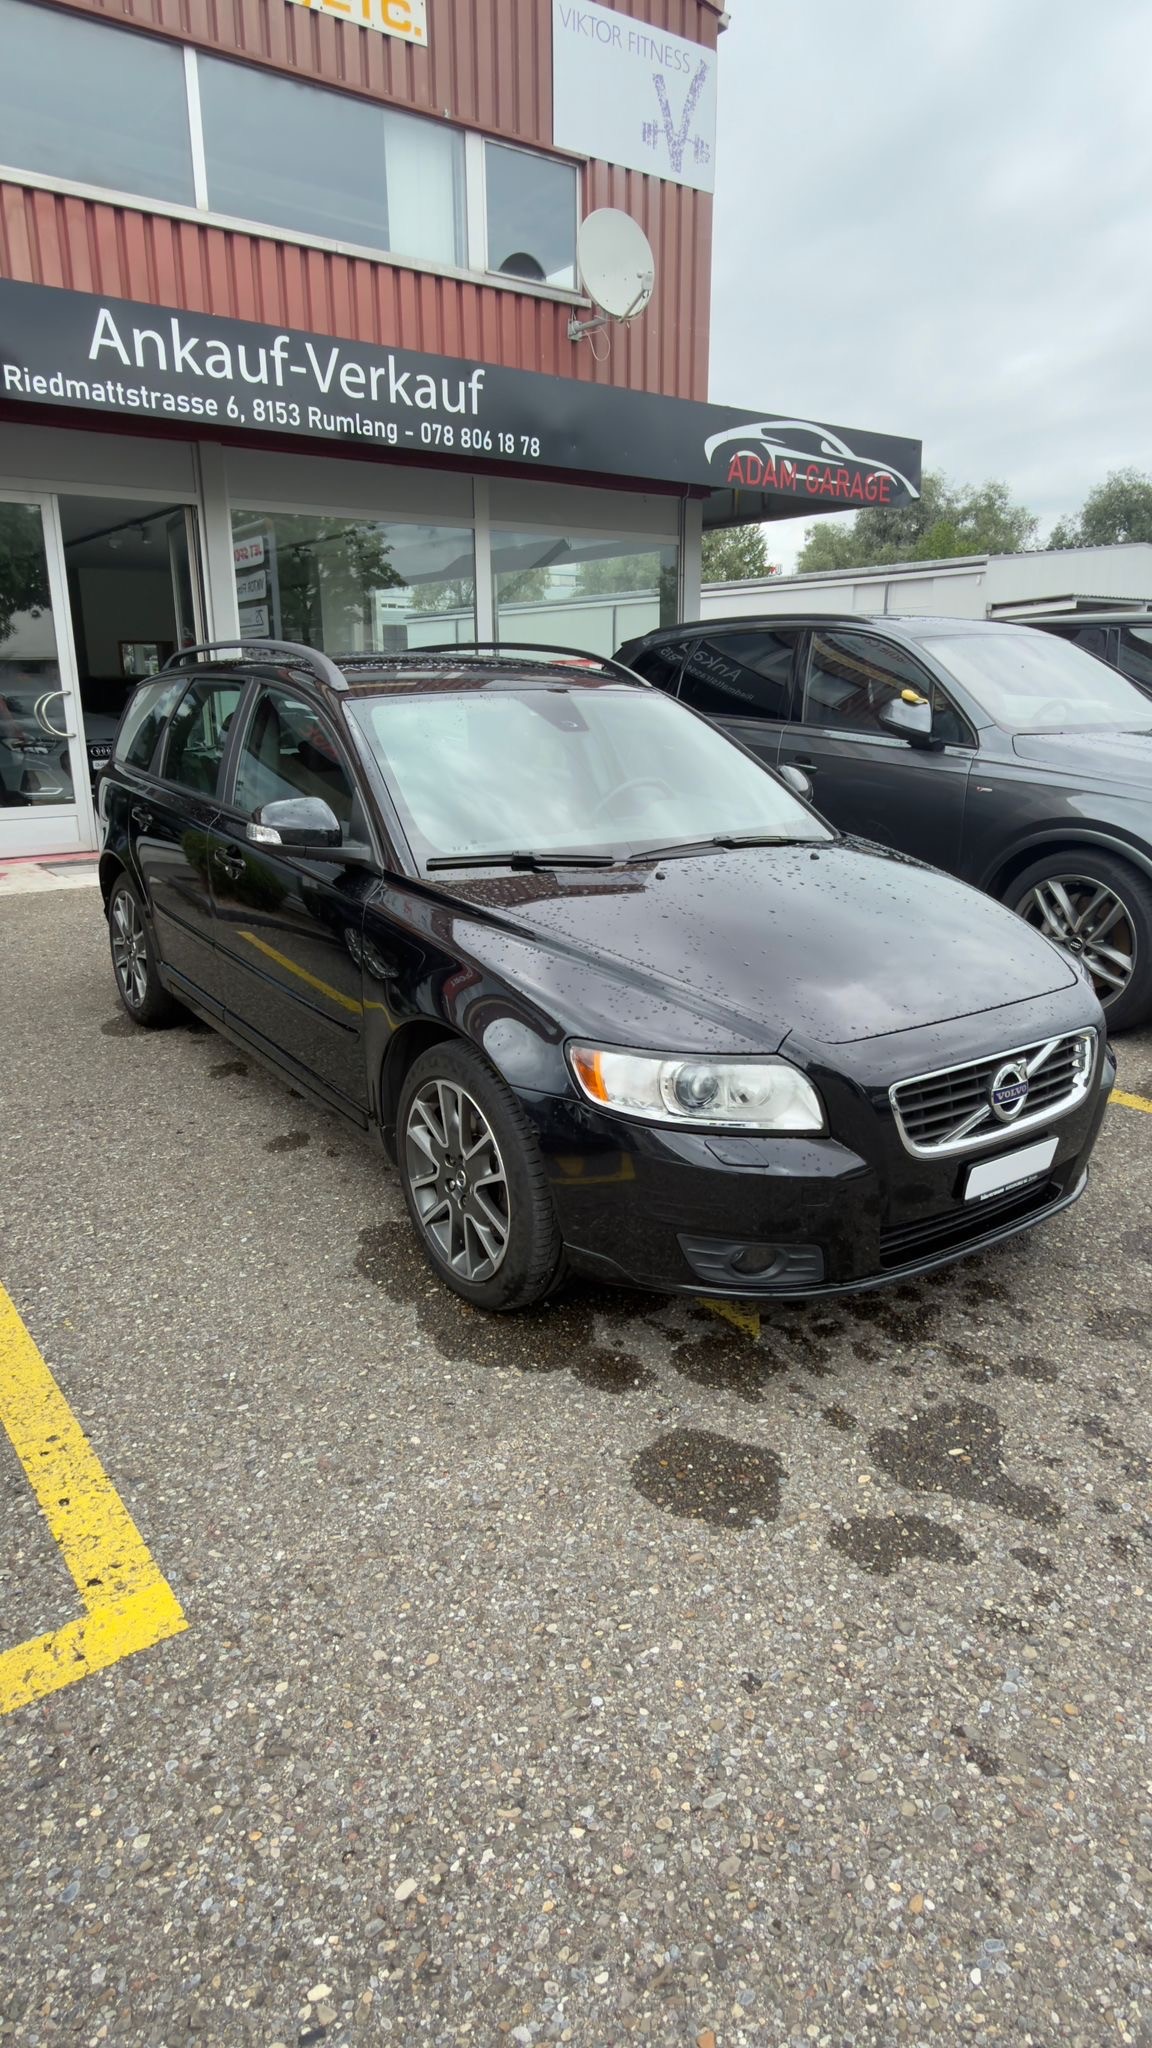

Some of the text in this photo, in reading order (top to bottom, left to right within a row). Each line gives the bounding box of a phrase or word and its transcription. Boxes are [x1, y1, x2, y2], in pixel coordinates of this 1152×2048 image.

[559, 4, 691, 74] VIKTOR FITNESS
[88, 308, 486, 415] Ankauf-Verkauf
[3, 364, 218, 417] Riedmattstrasse
[226, 396, 245, 423] 6,
[253, 399, 300, 426] 8153
[308, 406, 398, 444] Rumlang
[421, 422, 454, 446] 078
[461, 428, 492, 451] 806
[498, 432, 515, 454] 18
[520, 435, 540, 457] 78
[727, 454, 892, 503] ADAM GARAGE
[995, 1084, 1027, 1101] VOLVO
